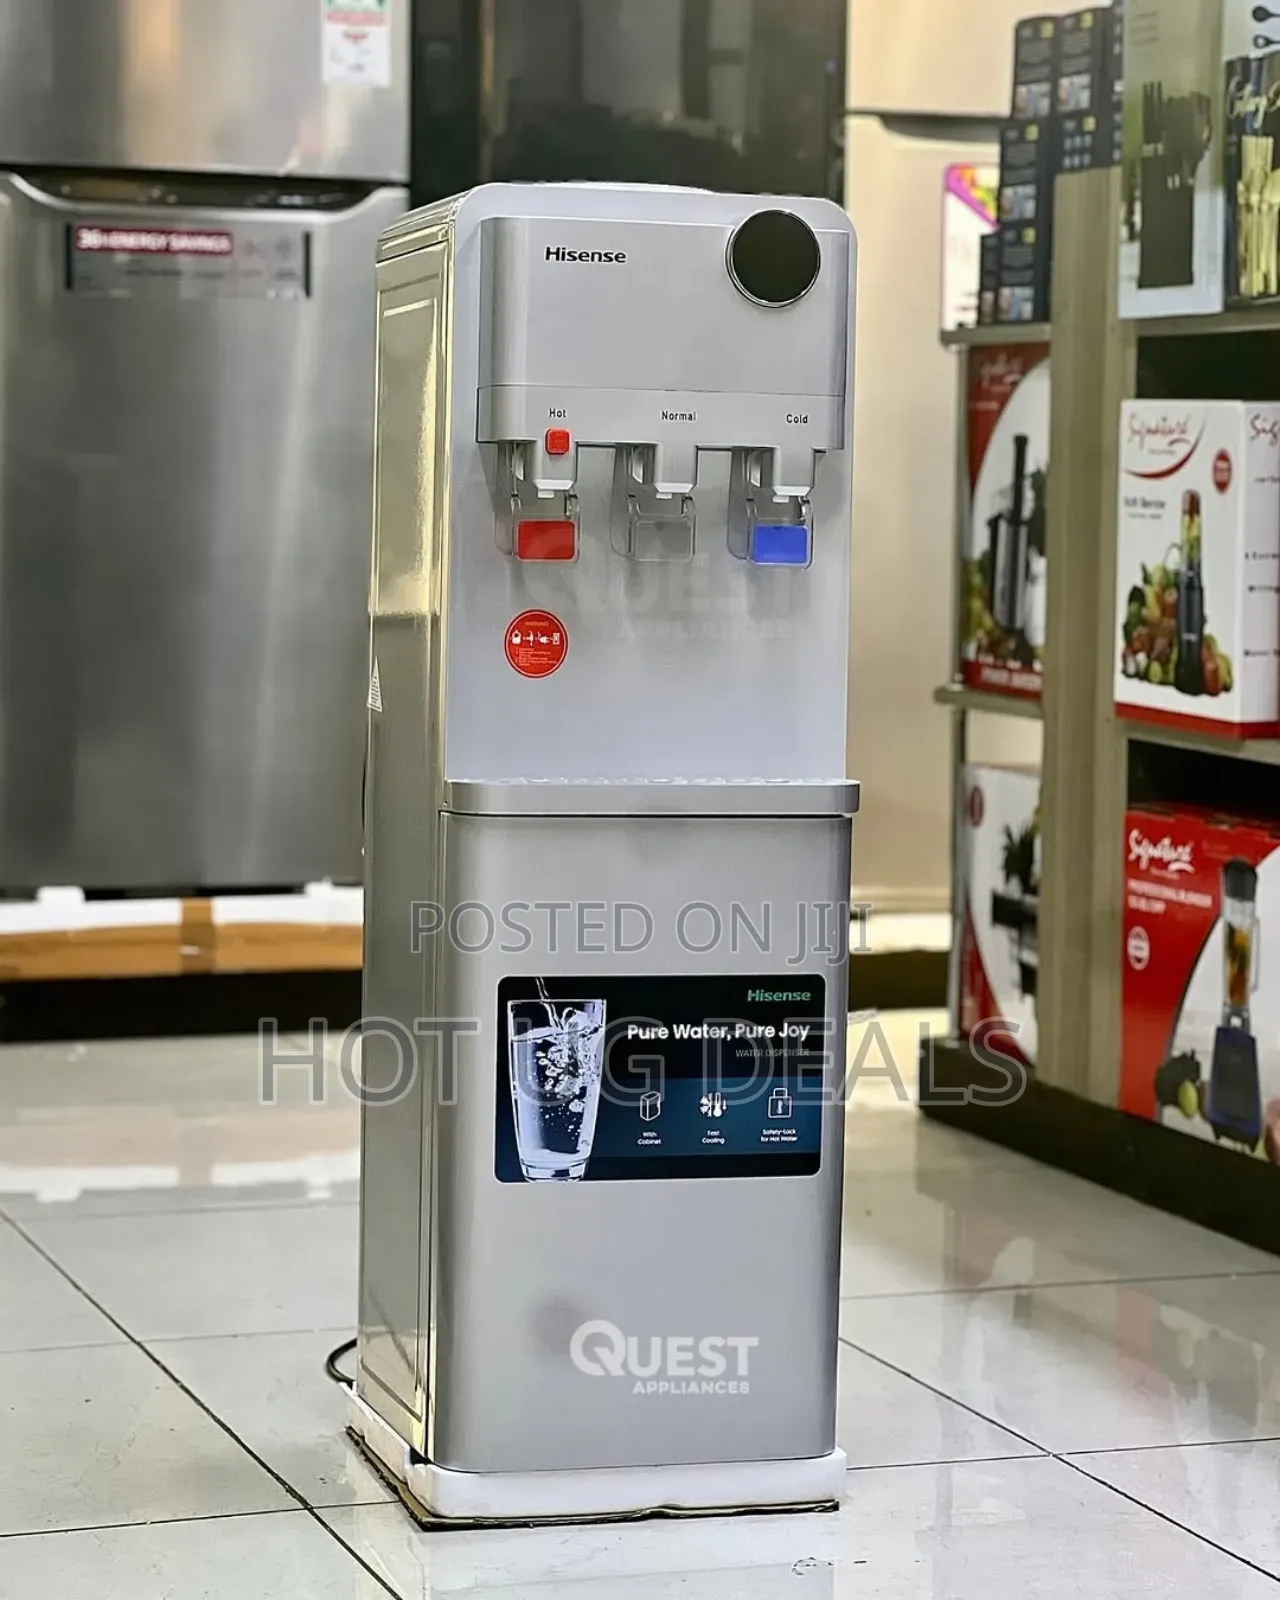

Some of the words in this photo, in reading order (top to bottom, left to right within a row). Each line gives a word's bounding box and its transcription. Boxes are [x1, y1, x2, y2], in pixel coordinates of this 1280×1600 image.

[545, 246, 627, 263] Hisense
[549, 408, 567, 418] Hot
[661, 410, 697, 421] Normal
[786, 414, 808, 424] Cold
[747, 989, 811, 1002] Hisense
[627, 1024, 669, 1040] Pure
[672, 1023, 732, 1041] Water,
[735, 1023, 775, 1039] Pure
[778, 1022, 810, 1041] Joy
[735, 1049, 764, 1058] WATER
[765, 1048, 810, 1057] DISPENSER
[702, 1137, 725, 1145] Cooling
